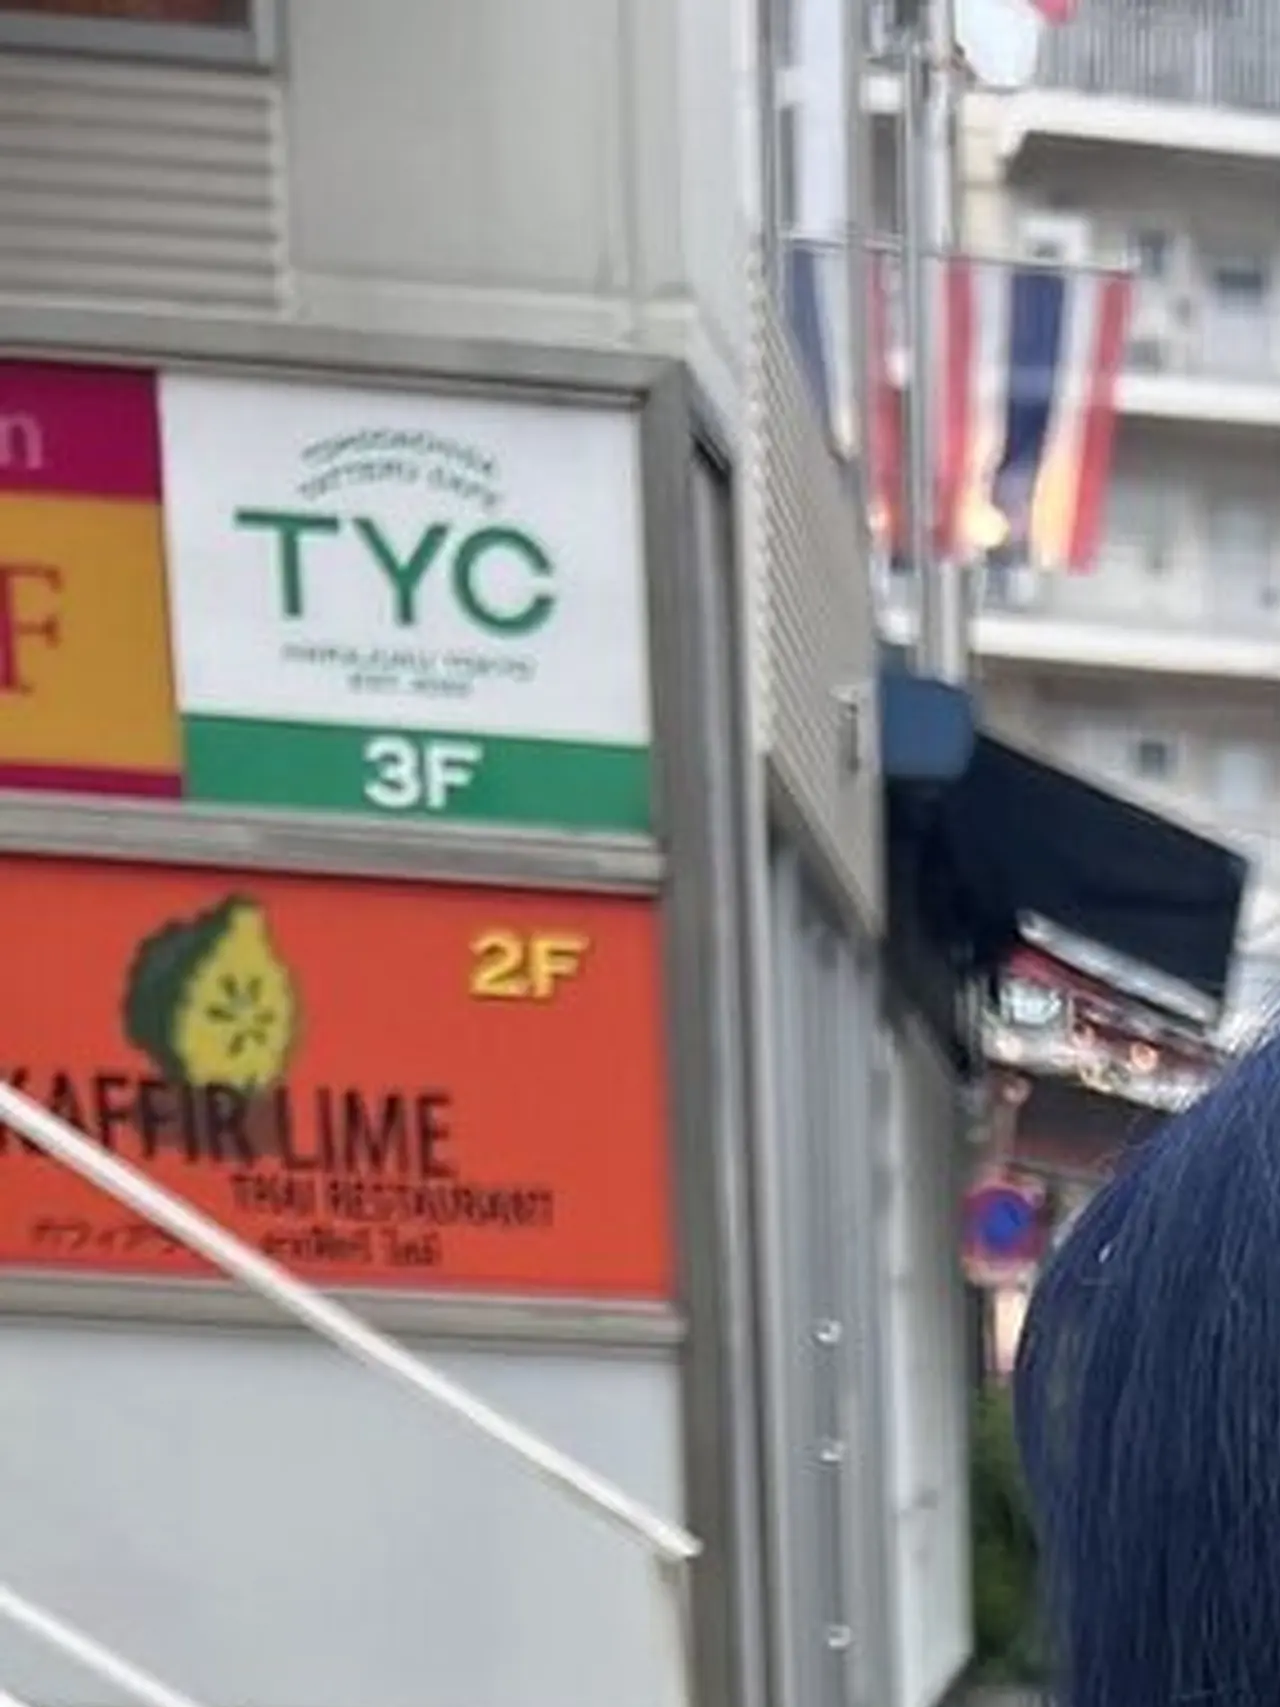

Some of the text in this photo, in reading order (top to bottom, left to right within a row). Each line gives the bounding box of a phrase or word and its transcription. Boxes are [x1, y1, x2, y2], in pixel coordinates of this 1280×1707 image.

[234, 510, 556, 637] TYC
[363, 736, 483, 808] 3F
[468, 929, 589, 999] 2F
[276, 1084, 457, 1176] LIME
